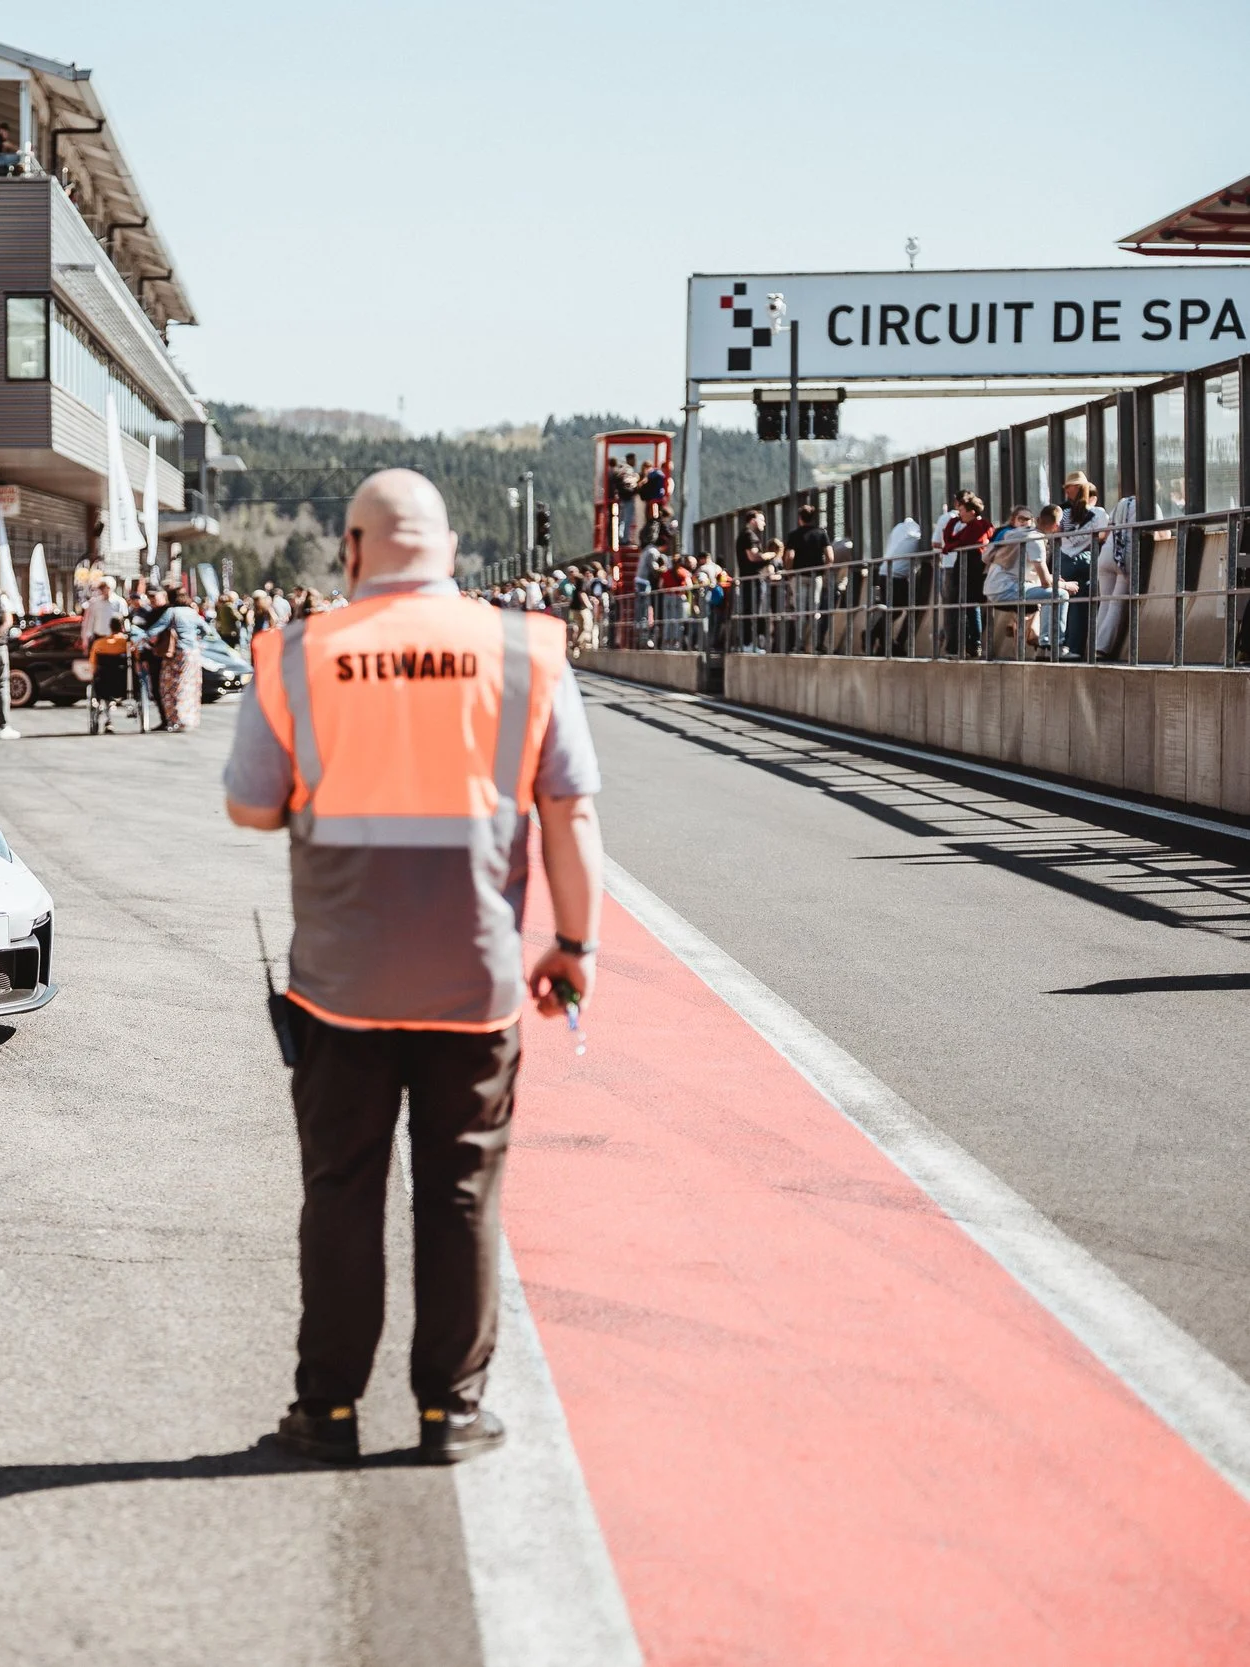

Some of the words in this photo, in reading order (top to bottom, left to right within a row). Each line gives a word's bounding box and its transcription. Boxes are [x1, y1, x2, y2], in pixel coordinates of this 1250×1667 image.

[828, 302, 1034, 346] CIRCUIT
[1053, 301, 1121, 342] DE
[1141, 298, 1246, 340] SPA
[337, 651, 477, 681] STEWARD
